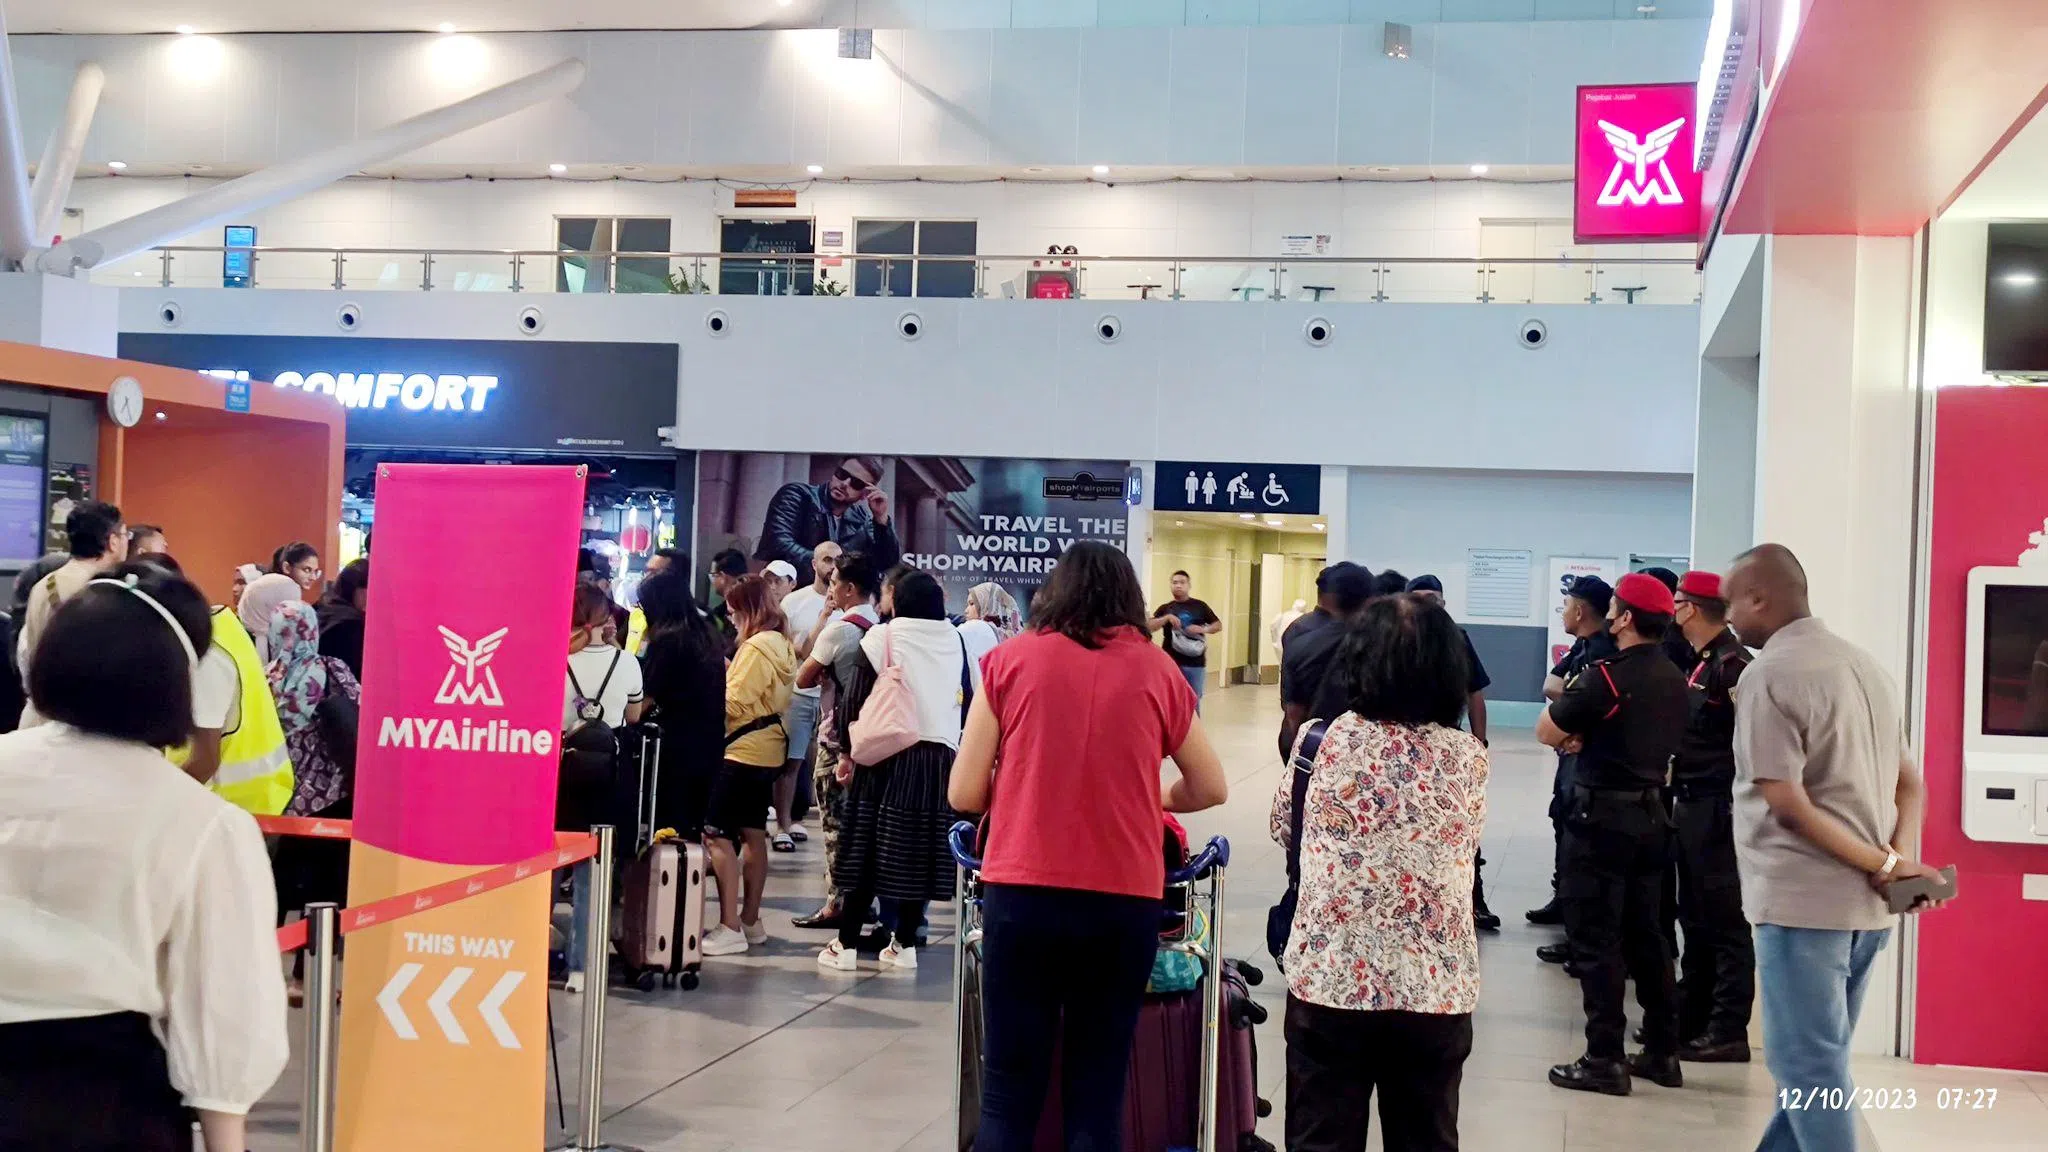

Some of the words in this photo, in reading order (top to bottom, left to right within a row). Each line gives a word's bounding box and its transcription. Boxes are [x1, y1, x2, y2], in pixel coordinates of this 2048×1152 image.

[980, 515, 1072, 533] TRAVEL
[1078, 517, 1126, 535] THE
[957, 535, 1051, 553] WORLD
[984, 576, 1014, 584] TRAVEL
[377, 716, 553, 756] MYAirline
[403, 931, 455, 956] THIS
[460, 935, 515, 960] WAY
